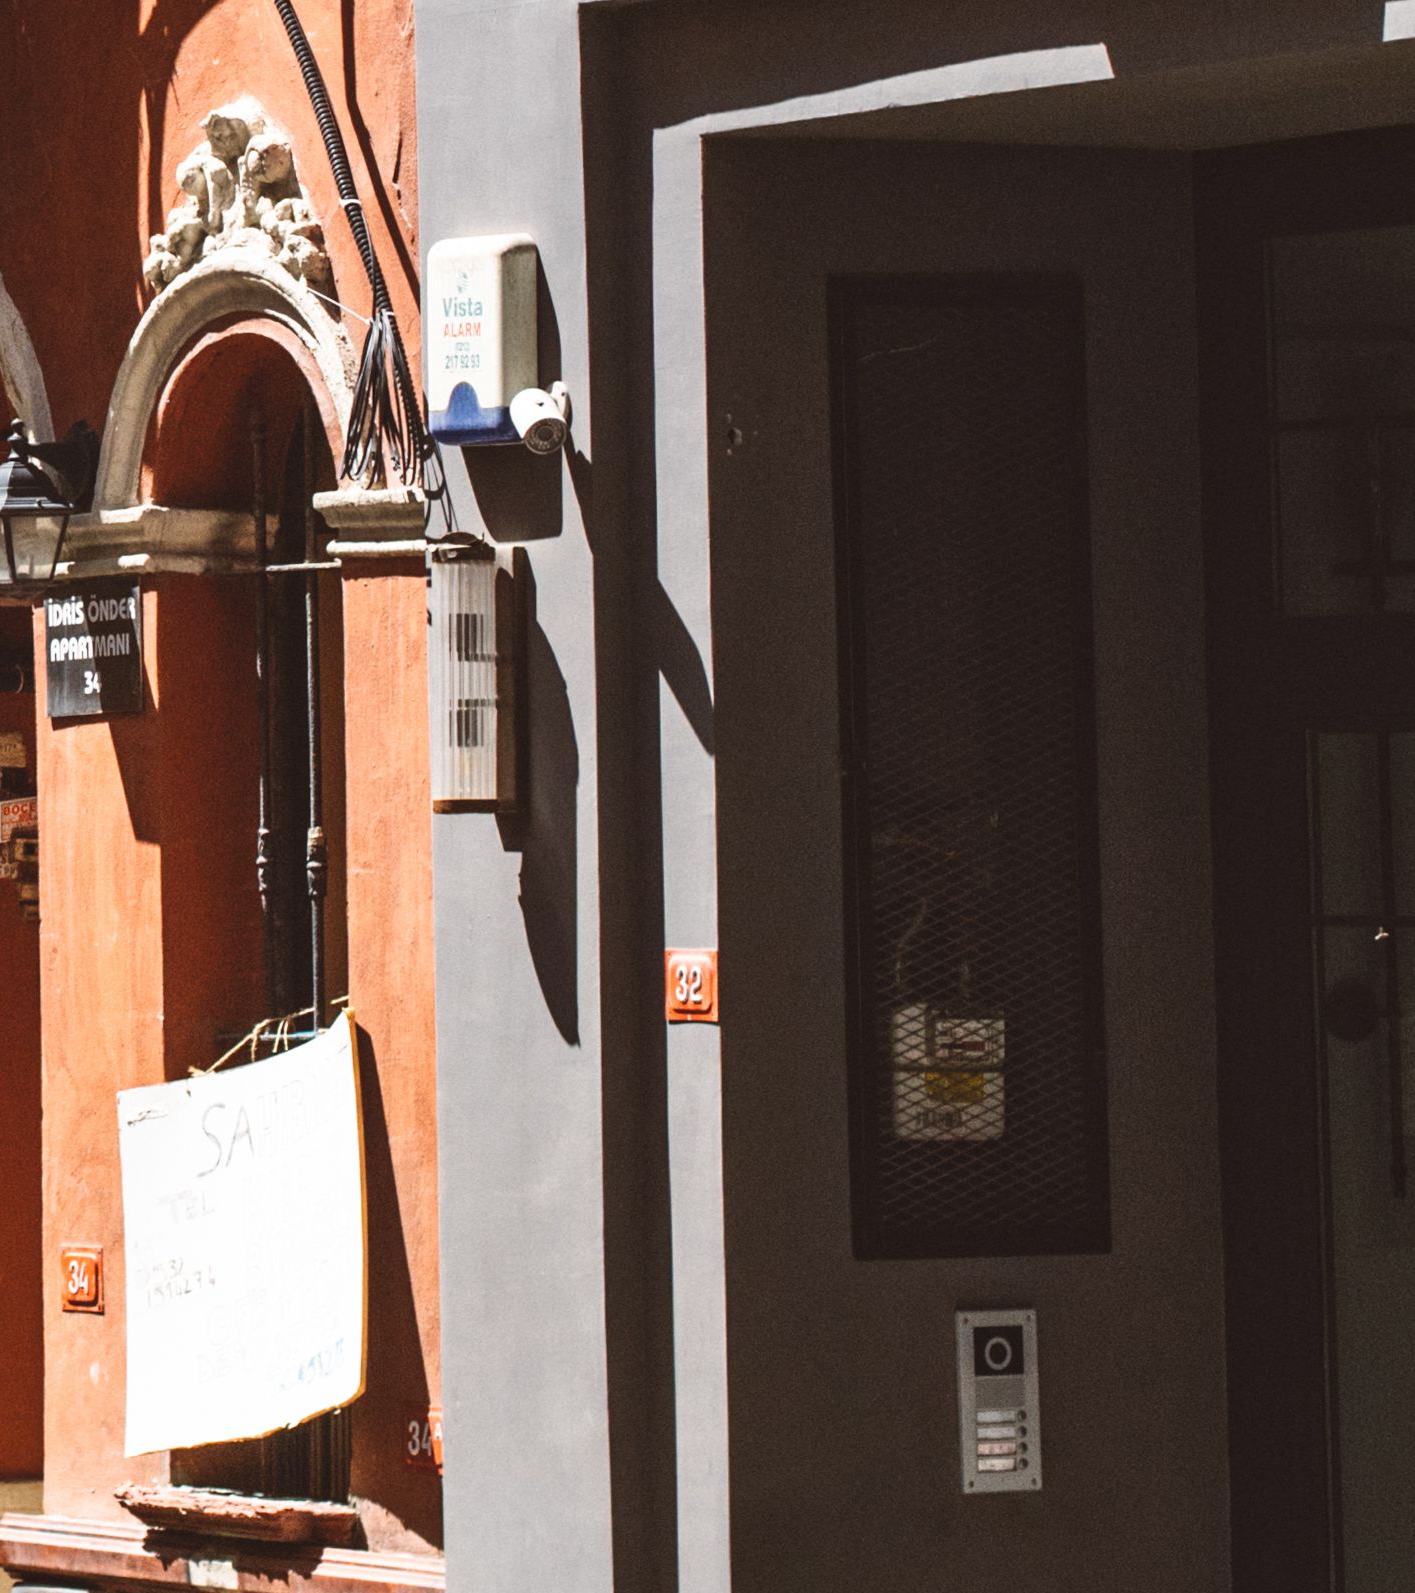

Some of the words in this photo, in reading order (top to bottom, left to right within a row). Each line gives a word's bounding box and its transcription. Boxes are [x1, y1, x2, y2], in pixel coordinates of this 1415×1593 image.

[443, 297, 483, 318] Vista
[444, 322, 481, 337] ALARM
[49, 596, 85, 627] İDRİS
[88, 595, 136, 623] ÖNDER
[50, 633, 130, 662] APARTMANI
[84, 670, 102, 695] 34
[675, 966, 702, 1002] 32
[68, 1259, 89, 1296] 34
[408, 1420, 432, 1457] 34
